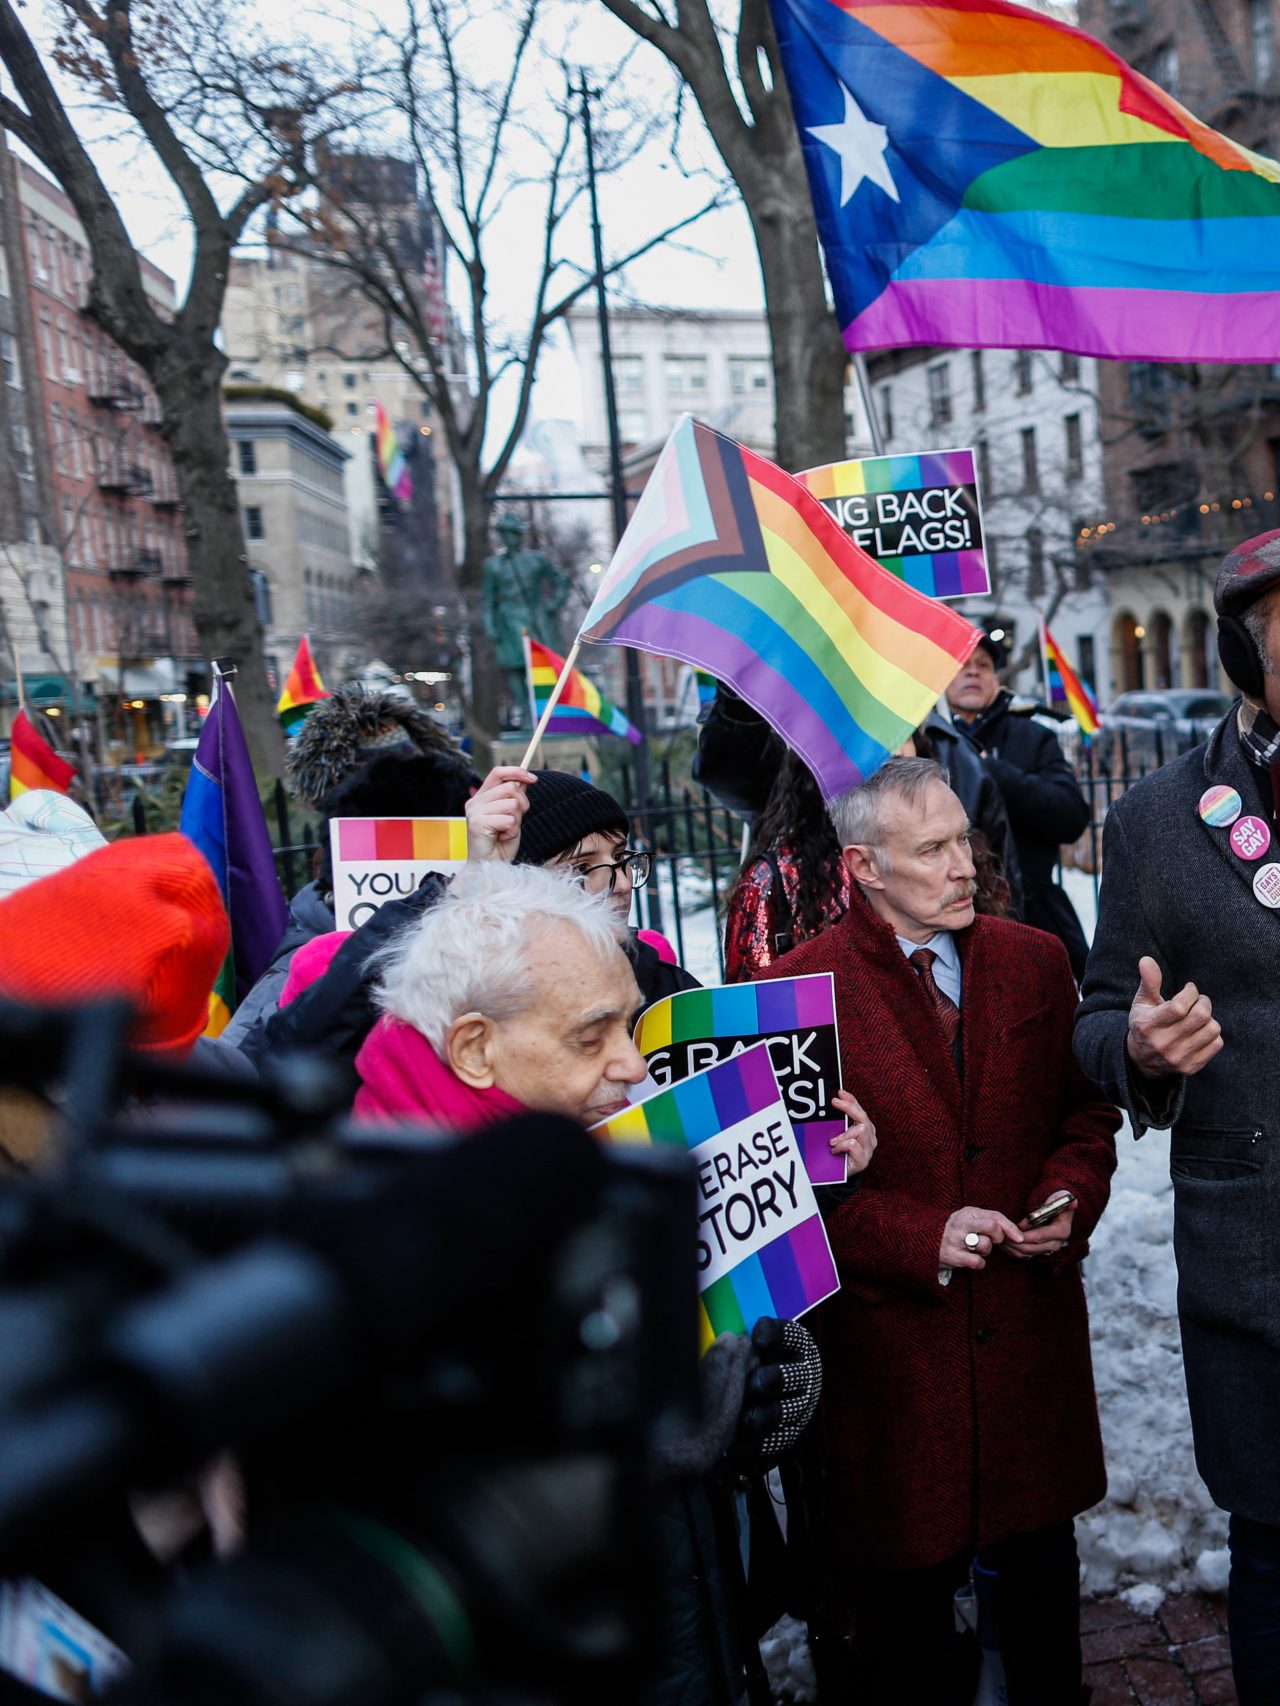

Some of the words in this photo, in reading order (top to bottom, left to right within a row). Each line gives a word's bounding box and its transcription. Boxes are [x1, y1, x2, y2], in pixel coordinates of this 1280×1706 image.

[876, 487, 967, 524] BACK
[852, 519, 972, 557] FLAGS!
[1232, 818, 1256, 846] SAY
[1241, 829, 1265, 857] GAY
[347, 872, 416, 897] YOU
[1260, 871, 1279, 890] GAYS
[687, 1031, 821, 1077] BCK
[698, 1120, 790, 1200] ERASE
